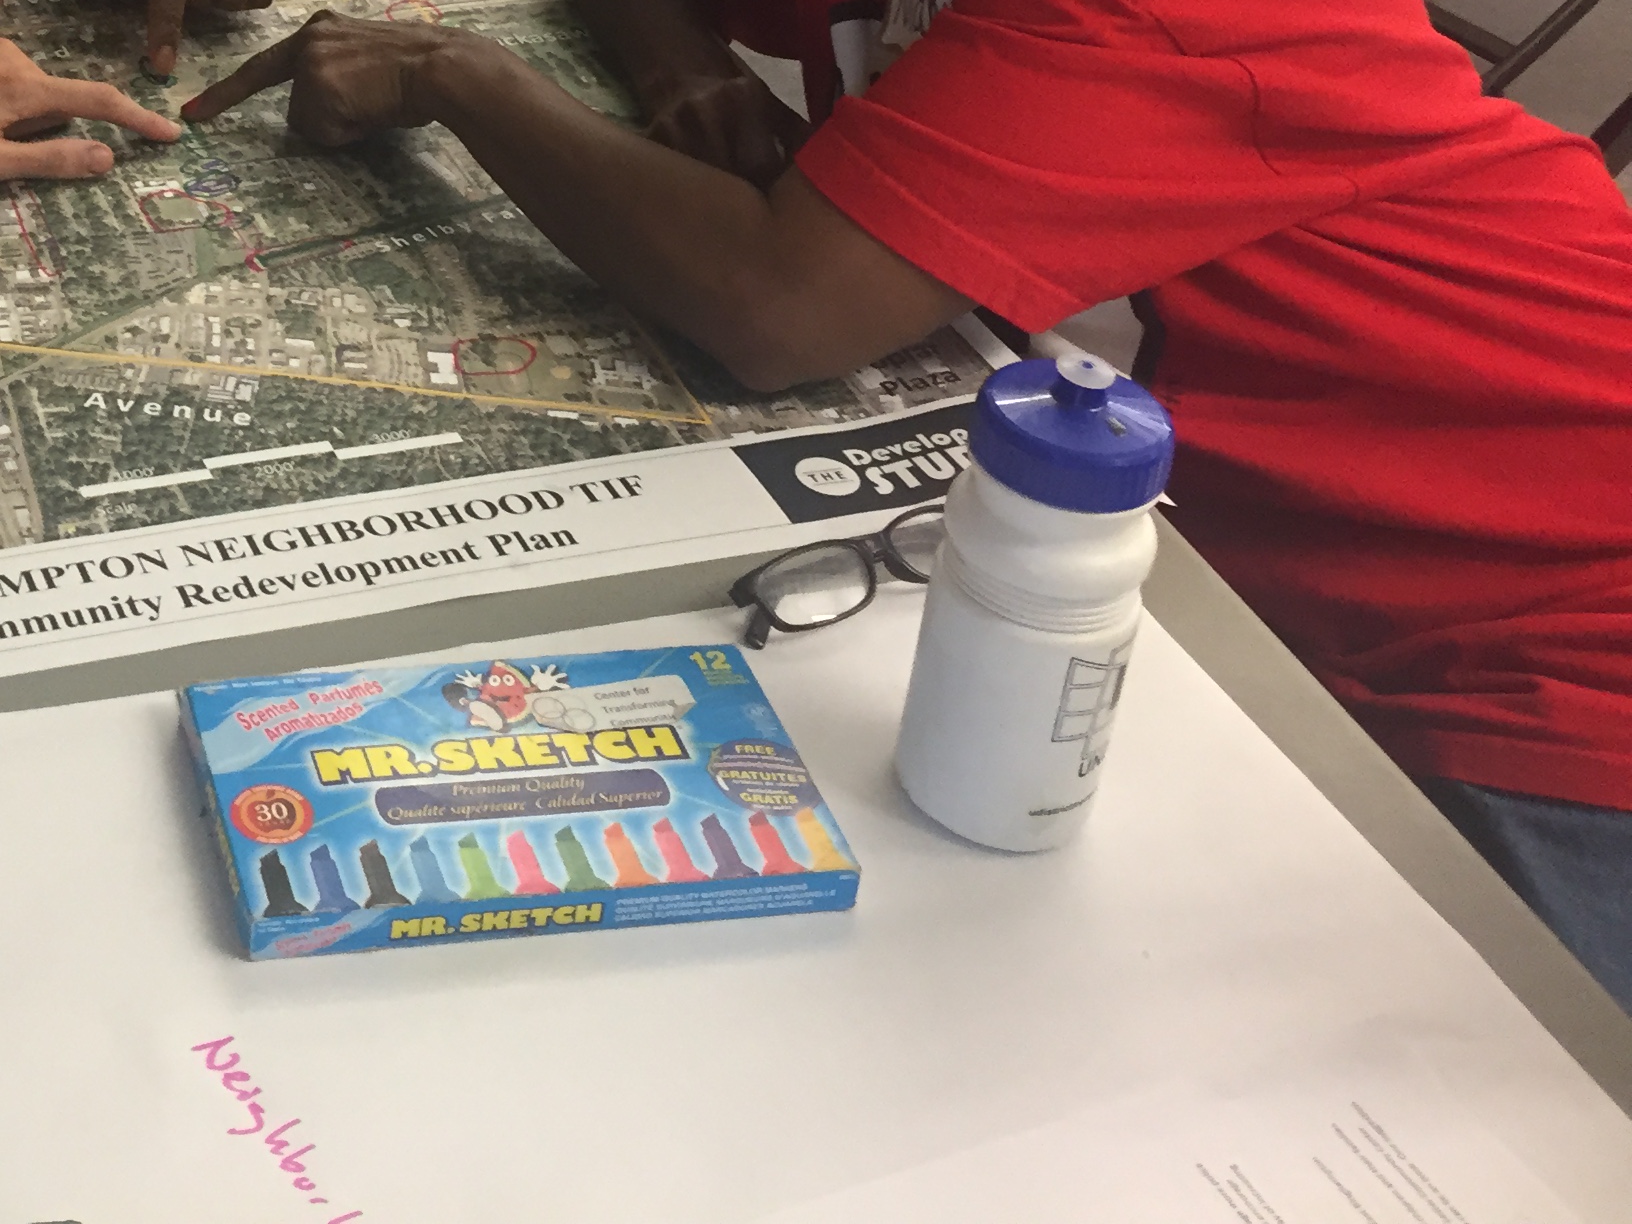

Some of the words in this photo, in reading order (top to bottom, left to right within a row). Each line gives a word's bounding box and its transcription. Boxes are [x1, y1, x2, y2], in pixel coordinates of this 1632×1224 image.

[374, 222, 473, 253] Shelby
[879, 370, 962, 397] Plaza
[82, 392, 253, 427] Avenue
[806, 470, 848, 484] THE
[842, 428, 969, 467] Develop
[180, 485, 567, 570] NEIGHBORHOOD
[571, 473, 644, 508] TIF
[178, 540, 481, 611] Redevelopment
[493, 524, 580, 555] Plan
[689, 651, 733, 672] 12
[594, 688, 631, 701] Center
[235, 698, 301, 732] Scented
[263, 701, 365, 743] Aromatizados
[431, 724, 691, 775] SKETCH
[734, 743, 776, 756] FREE
[525, 777, 586, 792] Quality
[718, 769, 808, 783] GRATUITES
[254, 801, 289, 823] 30
[739, 792, 800, 805] GRATIS
[459, 903, 603, 934] SKETCH
